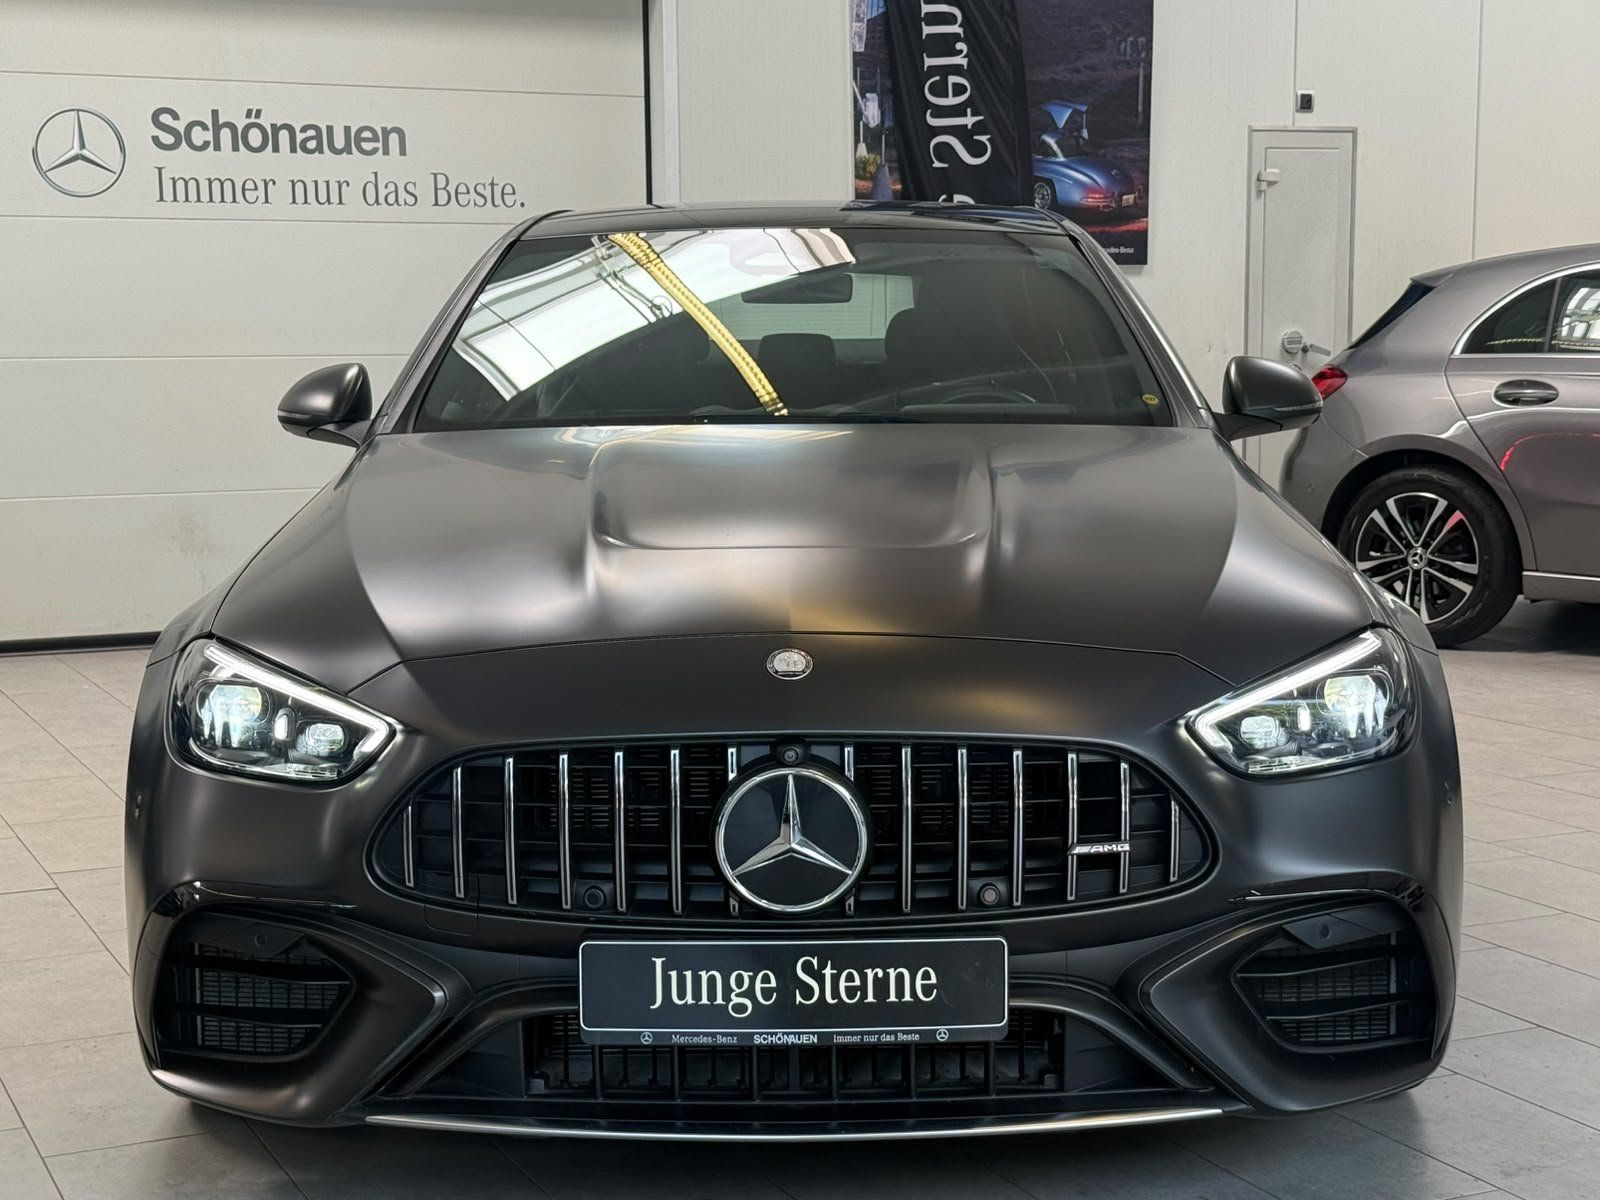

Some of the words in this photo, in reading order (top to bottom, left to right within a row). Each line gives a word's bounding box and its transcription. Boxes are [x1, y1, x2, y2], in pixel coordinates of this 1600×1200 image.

[150, 106, 407, 157] Schönauen
[154, 165, 277, 205] Immer
[288, 177, 350, 207] nur
[361, 171, 418, 208] das
[430, 172, 526, 209] Beste.
[1089, 843, 1131, 853] AMG
[650, 957, 777, 1018] Junge
[795, 955, 938, 1005] Sterne
[671, 1034, 738, 1044] Mercedes-Benz
[752, 1032, 818, 1045] SCHÖNAUEN
[833, 1034, 861, 1043] Immer
[880, 1033, 895, 1042] das
[897, 1032, 920, 1041] Beste
